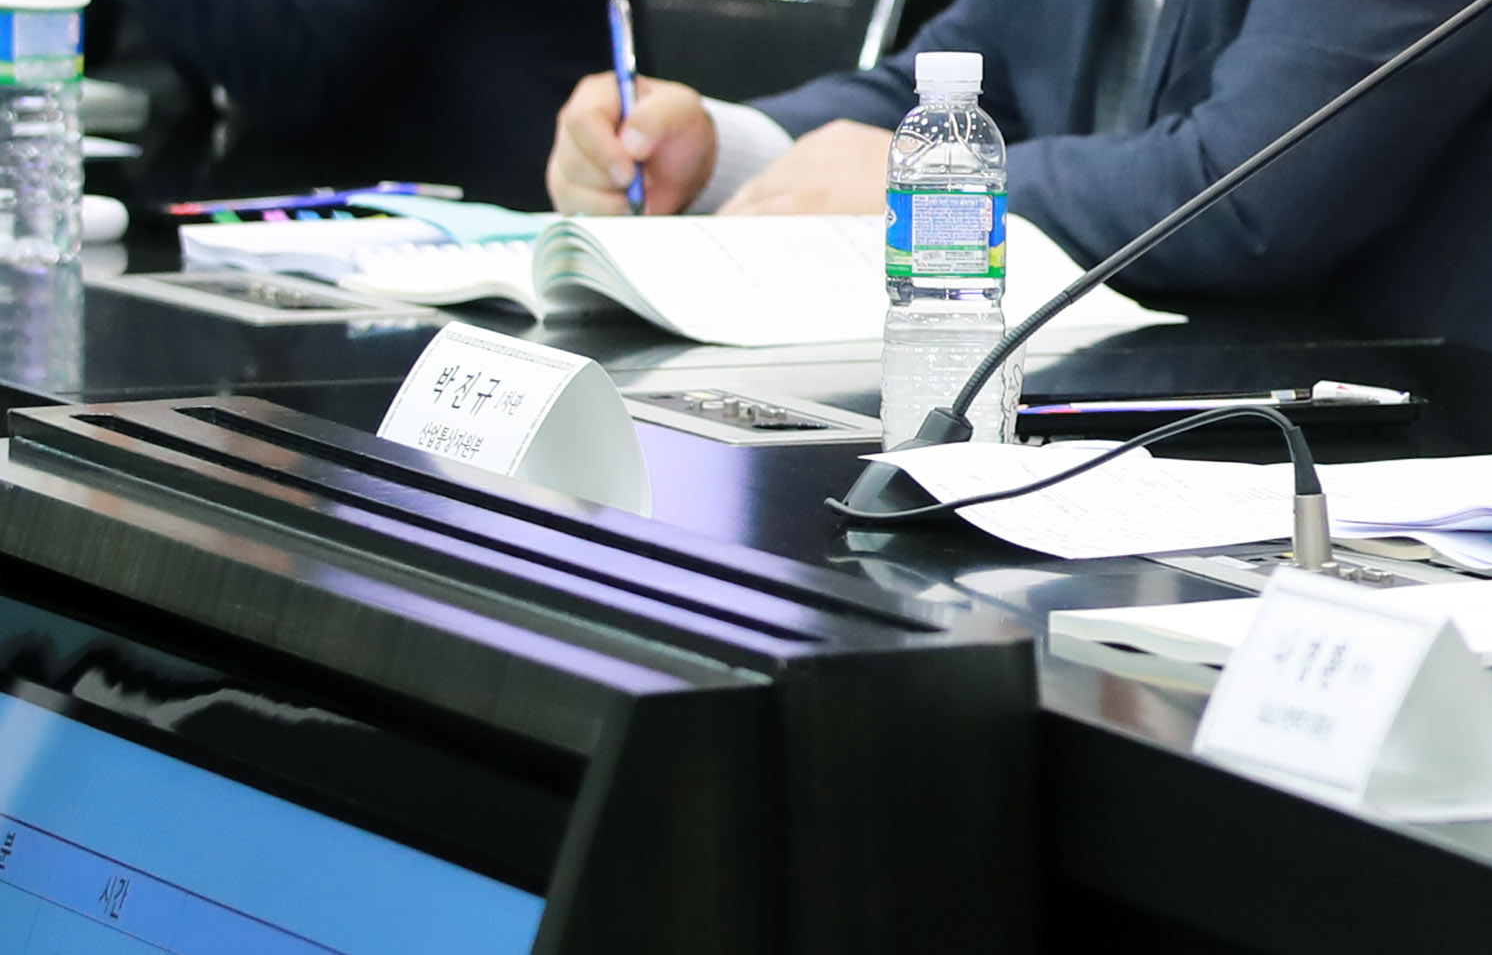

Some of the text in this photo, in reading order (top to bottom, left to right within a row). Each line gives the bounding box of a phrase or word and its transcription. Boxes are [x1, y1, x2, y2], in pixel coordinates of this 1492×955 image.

[433, 365, 501, 416] 박진규
[417, 421, 486, 460] 산업통상자원부
[99, 875, 131, 920] 시간
